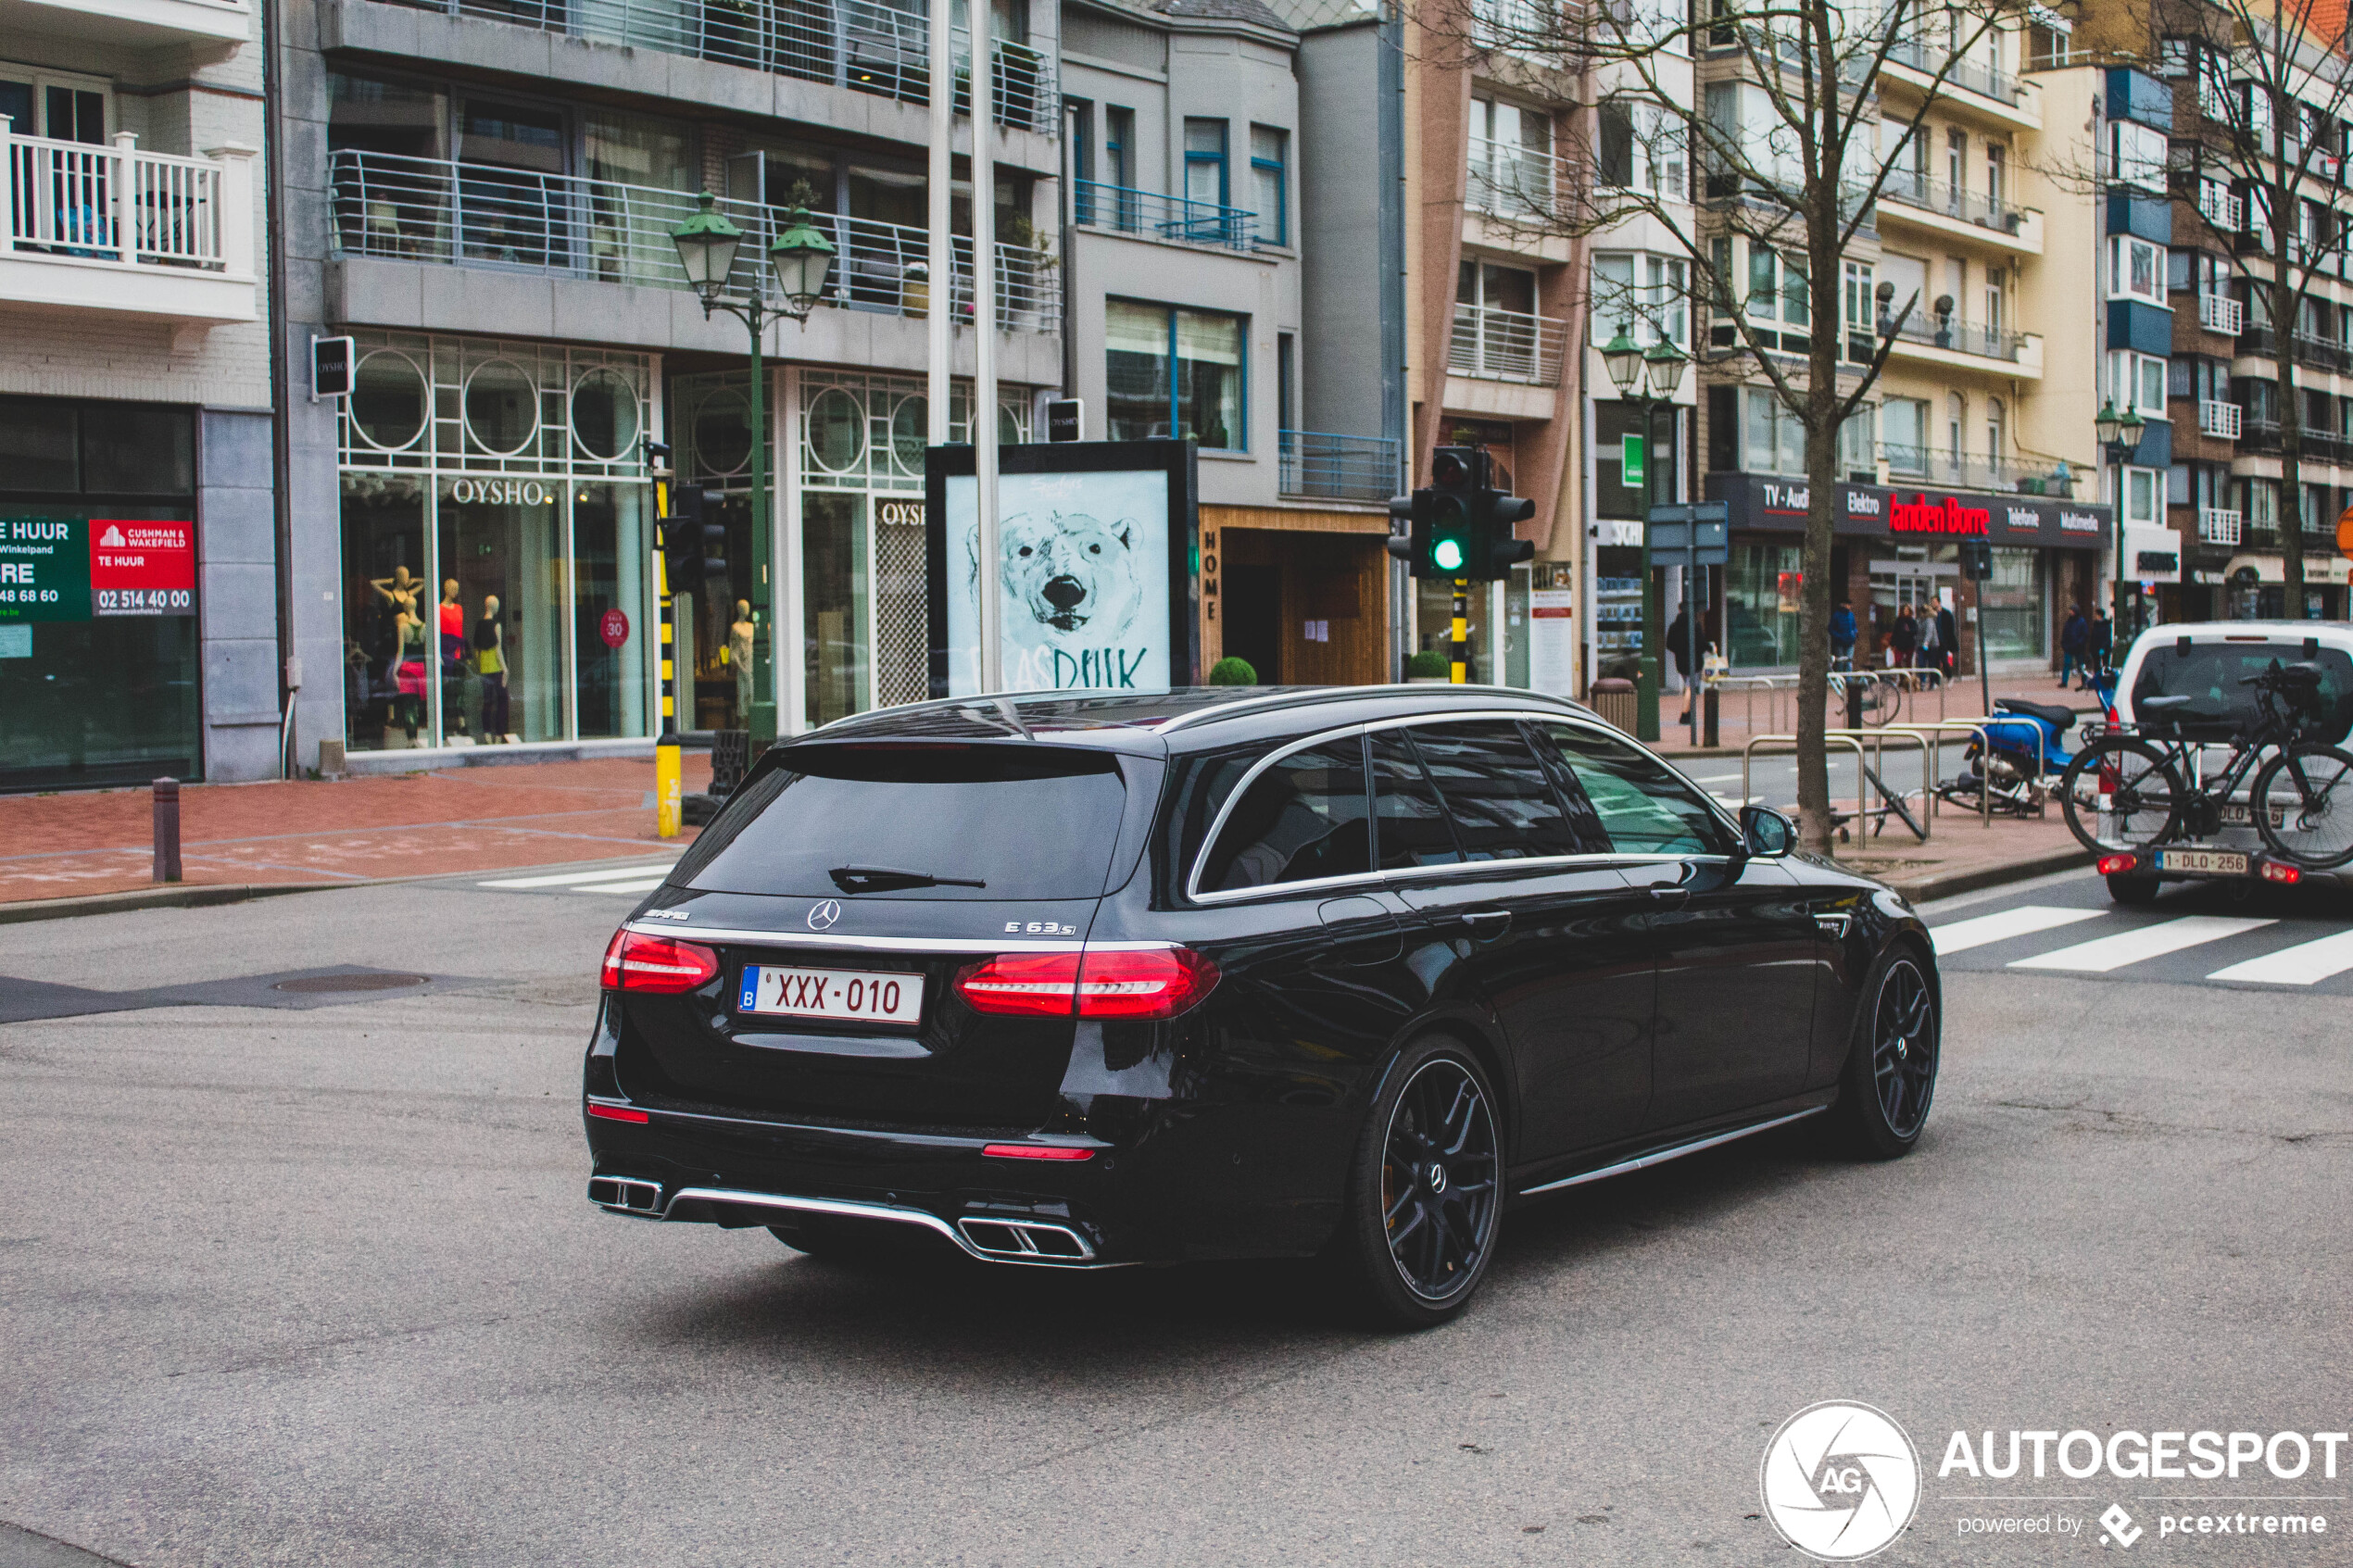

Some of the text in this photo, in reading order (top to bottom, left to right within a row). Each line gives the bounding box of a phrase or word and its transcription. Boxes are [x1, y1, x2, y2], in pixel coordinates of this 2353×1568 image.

[453, 478, 544, 506] OYSHO
[1763, 483, 1780, 508] TV
[1847, 491, 1880, 515] Elektro
[1947, 496, 1991, 535] Borre
[2007, 507, 2040, 527] Telefonie
[2060, 510, 2099, 532] Multimedia
[13, 522, 69, 540] HUUR
[128, 529, 176, 538] CUSHMAN
[129, 538, 185, 547] WAKEFIELD
[98, 556, 145, 567] TE HUUR
[1204, 531, 1217, 621] HOME
[19, 590, 37, 602] 68
[40, 590, 58, 602] 60
[98, 590, 191, 608] 02 514 40 00
[1004, 922, 1022, 933] E
[743, 991, 754, 1007] B
